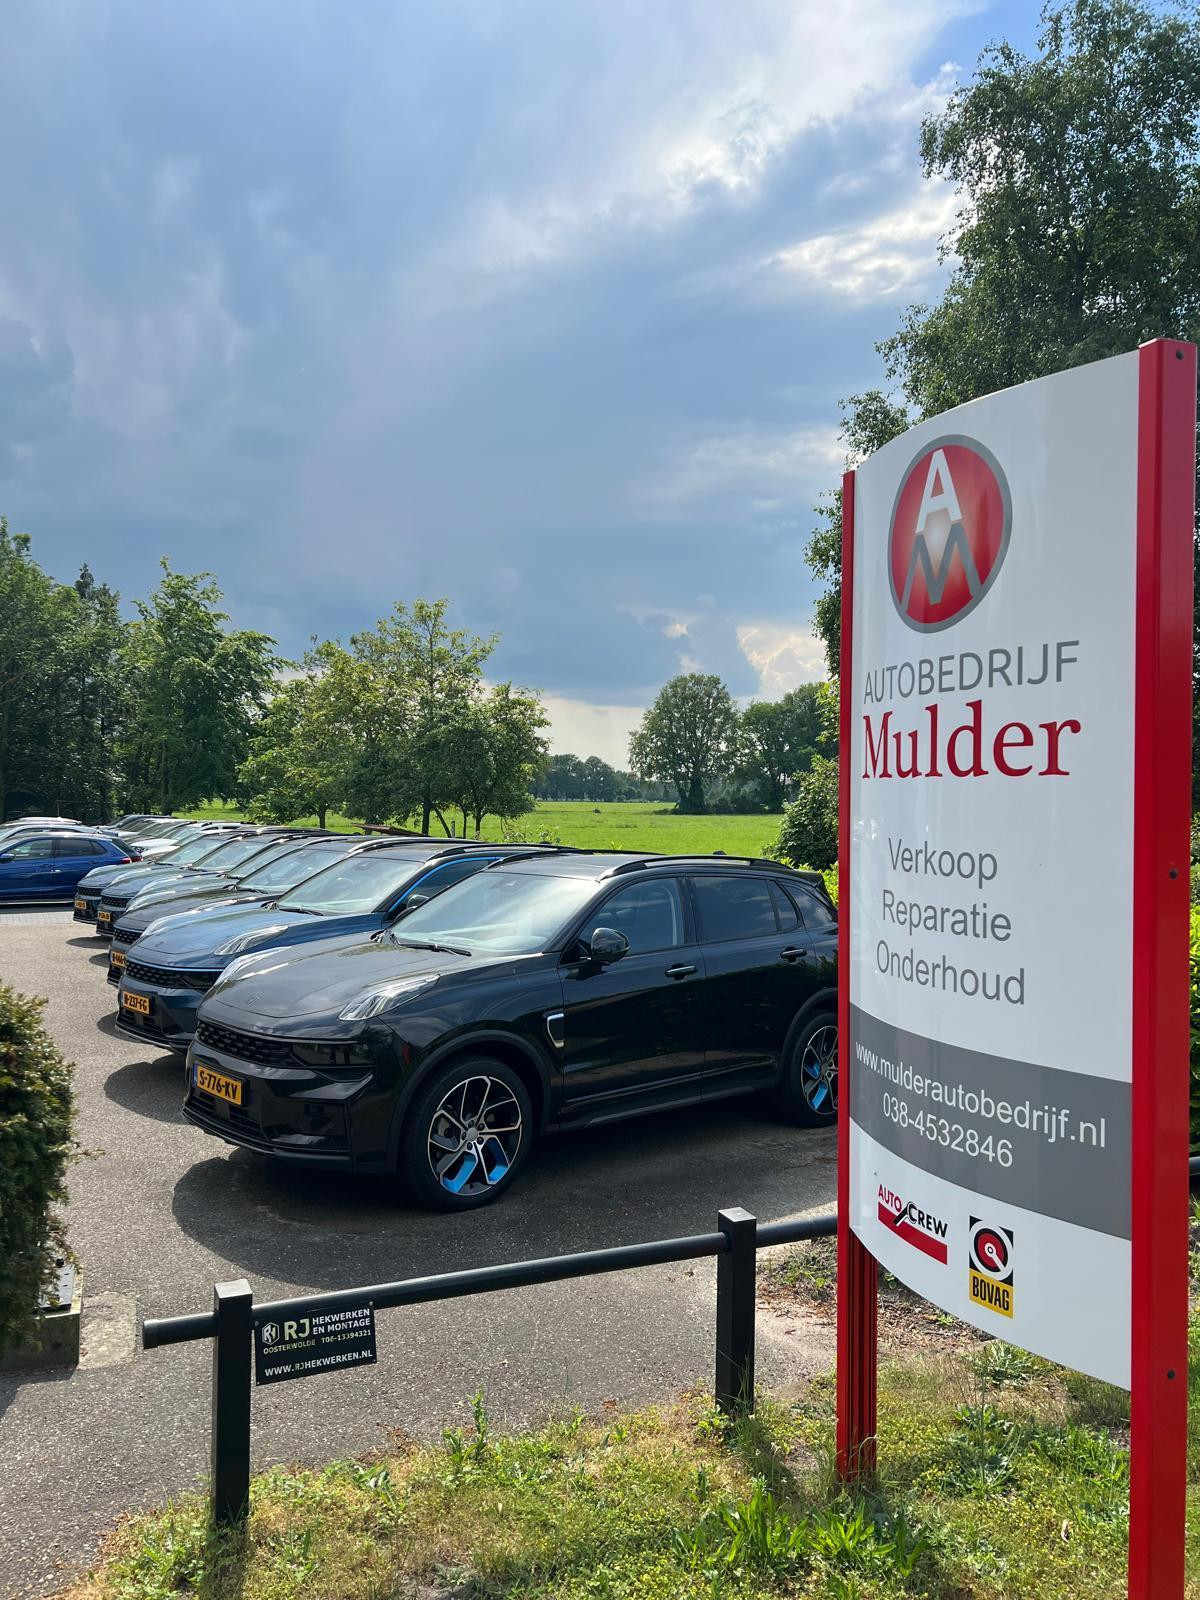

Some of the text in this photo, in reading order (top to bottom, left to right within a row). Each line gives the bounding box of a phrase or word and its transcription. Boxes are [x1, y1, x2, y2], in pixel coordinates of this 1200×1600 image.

[864, 640, 1080, 705] AUTOBEDRIJF
[862, 699, 1081, 779] Mulder
[888, 837, 998, 889] Verkoop
[882, 889, 1012, 942] Reparatie
[876, 940, 1025, 1005] Onderhoud
[199, 1070, 238, 1099] S-776-KV
[855, 1041, 1107, 1148] www.mulderautobedrijf.nl
[883, 1092, 1013, 1168] 038-4532846
[972, 1275, 1010, 1311] BOVAG
[284, 1318, 310, 1340] RJ
[312, 1308, 370, 1325] HEKWERKEN
[312, 1317, 371, 1335] EN MONTAGE
[263, 1338, 317, 1355] OOSTERWOLDE
[265, 1350, 373, 1376] WWW.RJHEKWERKEN.NL
